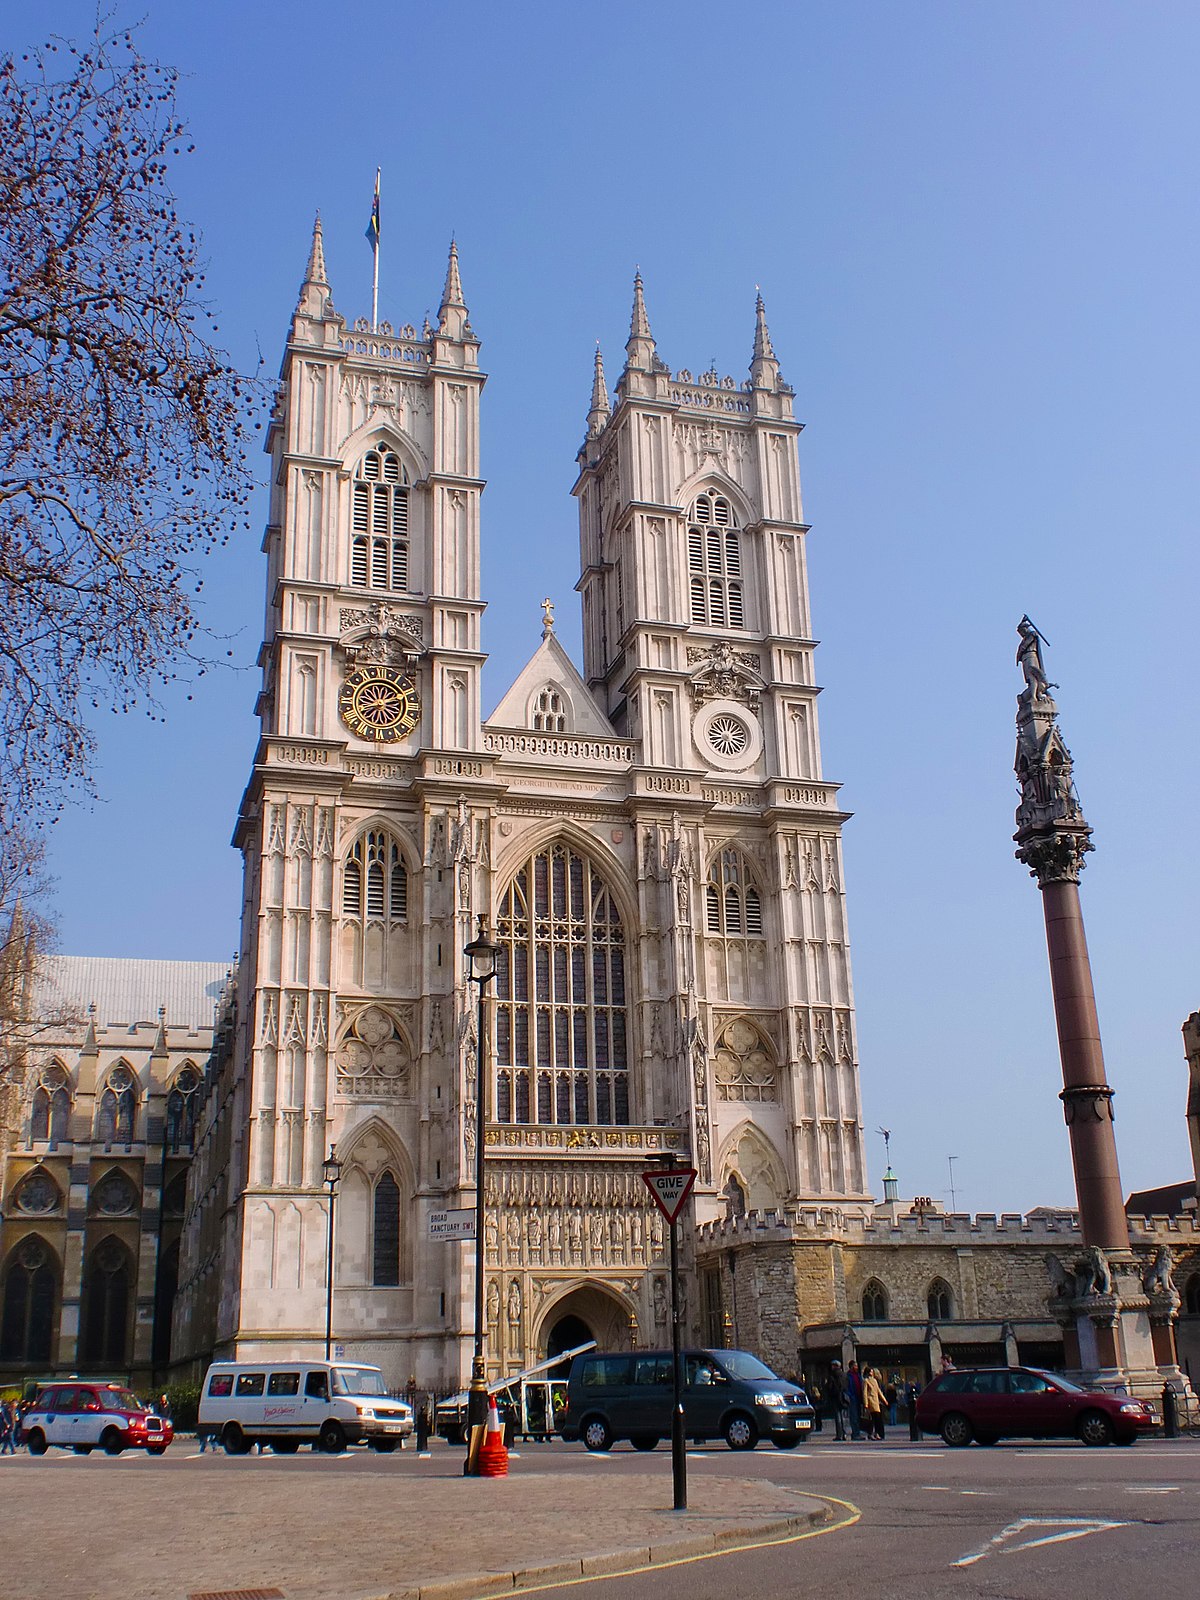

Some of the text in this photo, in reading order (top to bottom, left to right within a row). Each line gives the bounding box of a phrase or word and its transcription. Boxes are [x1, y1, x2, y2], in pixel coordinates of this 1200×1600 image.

[656, 1176, 683, 1189] GIVE
[662, 1191, 679, 1199] WAY
[430, 1214, 448, 1223] BROAD
[430, 1221, 473, 1233] SANCTUARY SW1
